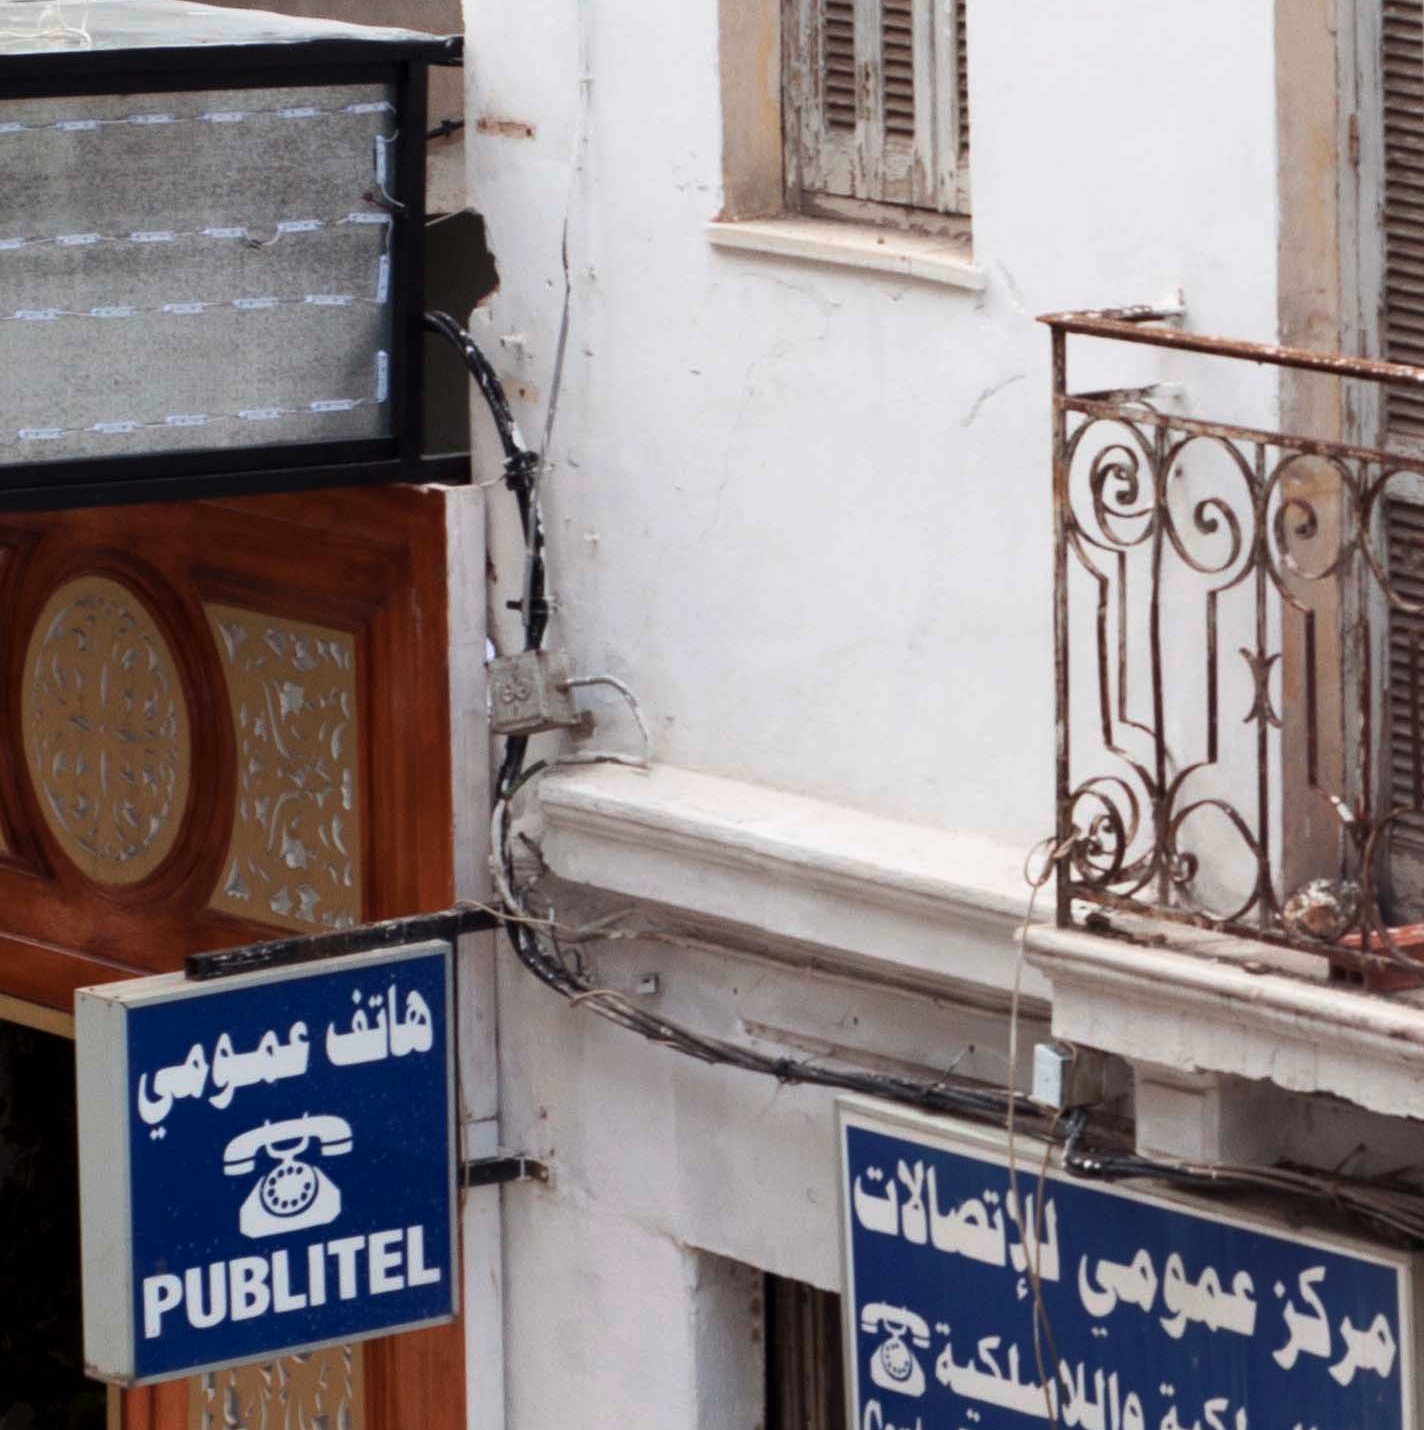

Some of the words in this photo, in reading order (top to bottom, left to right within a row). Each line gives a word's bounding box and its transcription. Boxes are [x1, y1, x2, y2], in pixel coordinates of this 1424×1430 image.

[136, 1018, 310, 1141] عمومي
[326, 982, 433, 1068] هاتف
[143, 1224, 441, 1340] PUBLITEL
[1077, 1246, 1258, 1339] عمومي
[1272, 1264, 1397, 1387] مركز
